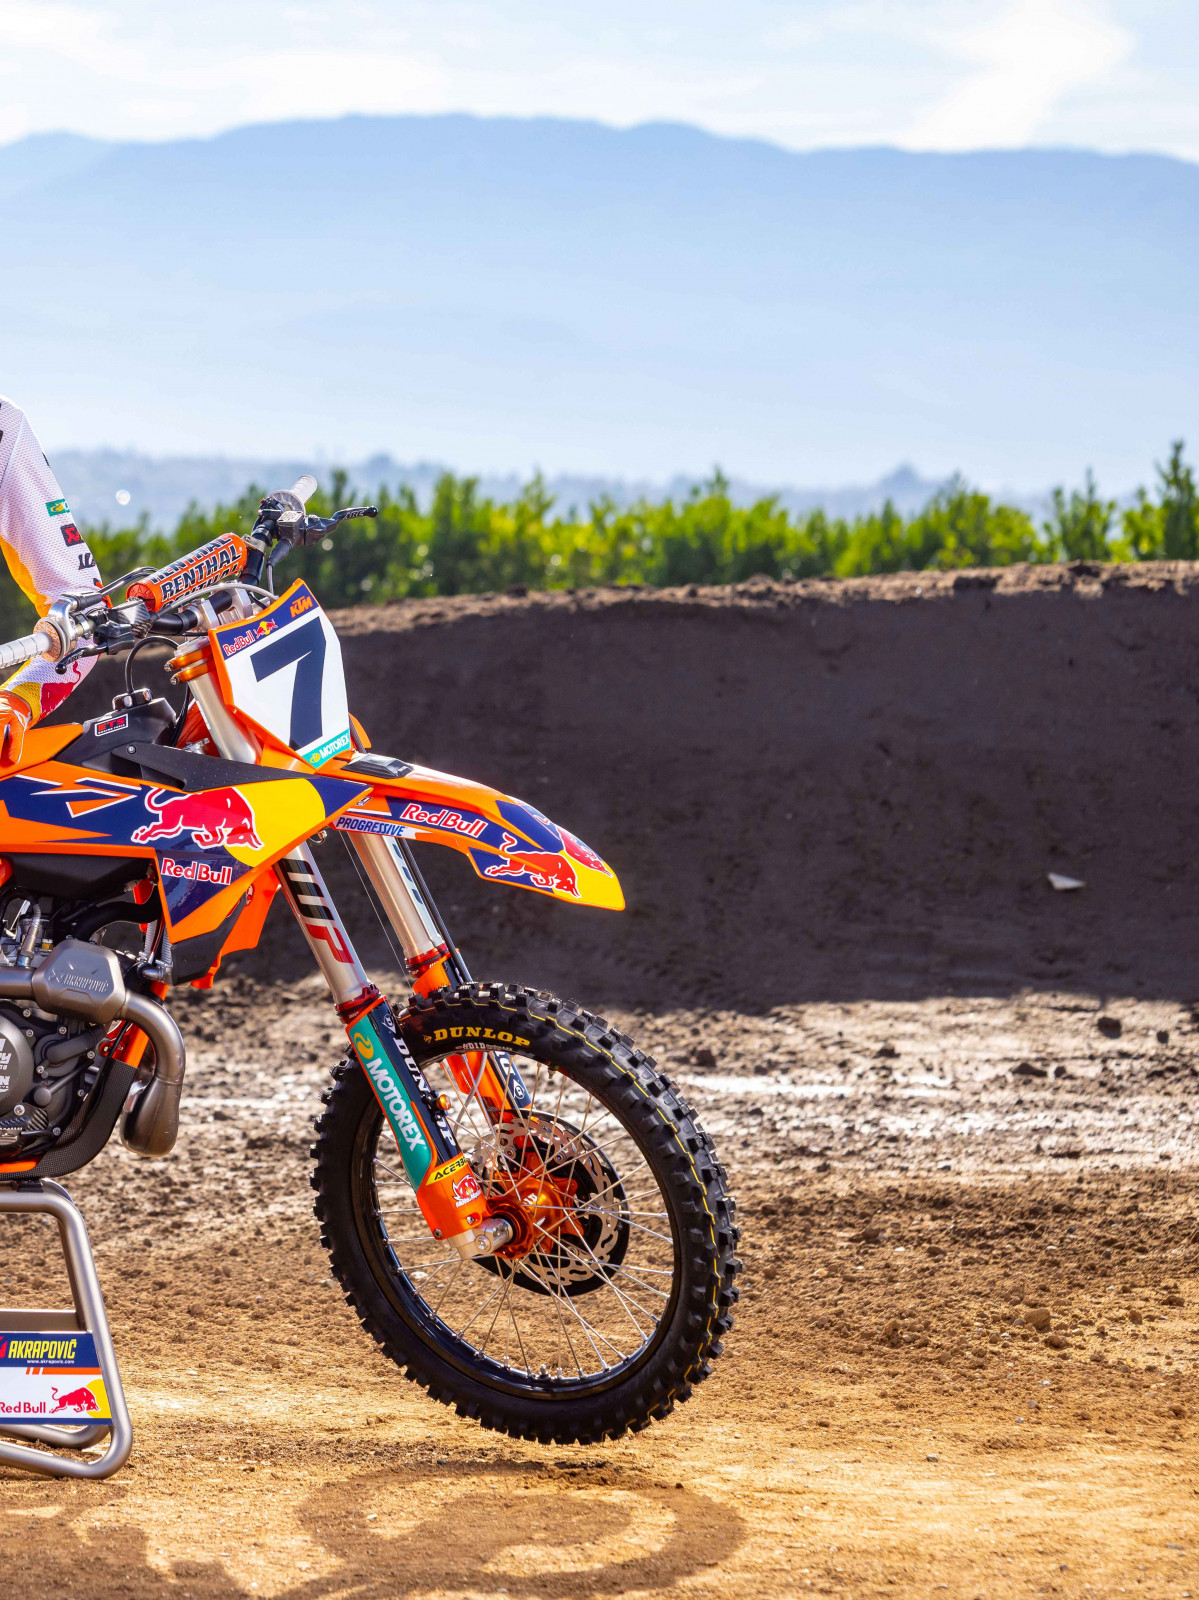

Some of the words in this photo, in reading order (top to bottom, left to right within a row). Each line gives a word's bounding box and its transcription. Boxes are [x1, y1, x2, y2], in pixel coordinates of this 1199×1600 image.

[160, 544, 242, 602] RENTHAL
[289, 595, 313, 618] KTM
[223, 635, 241, 656] Red
[238, 630, 255, 649] Bull
[250, 616, 326, 751] 7
[98, 717, 126, 731] ETS
[319, 733, 350, 759] MOTOREX
[336, 817, 405, 836] PROGRESSIVE
[400, 803, 448, 826] Red
[442, 811, 488, 838] Bull
[161, 858, 197, 879] Red
[197, 863, 233, 885] Bull
[433, 1026, 531, 1047] DUNLOP
[365, 1057, 426, 1151] MOTOREX
[23, 1402, 46, 1413] Bull
